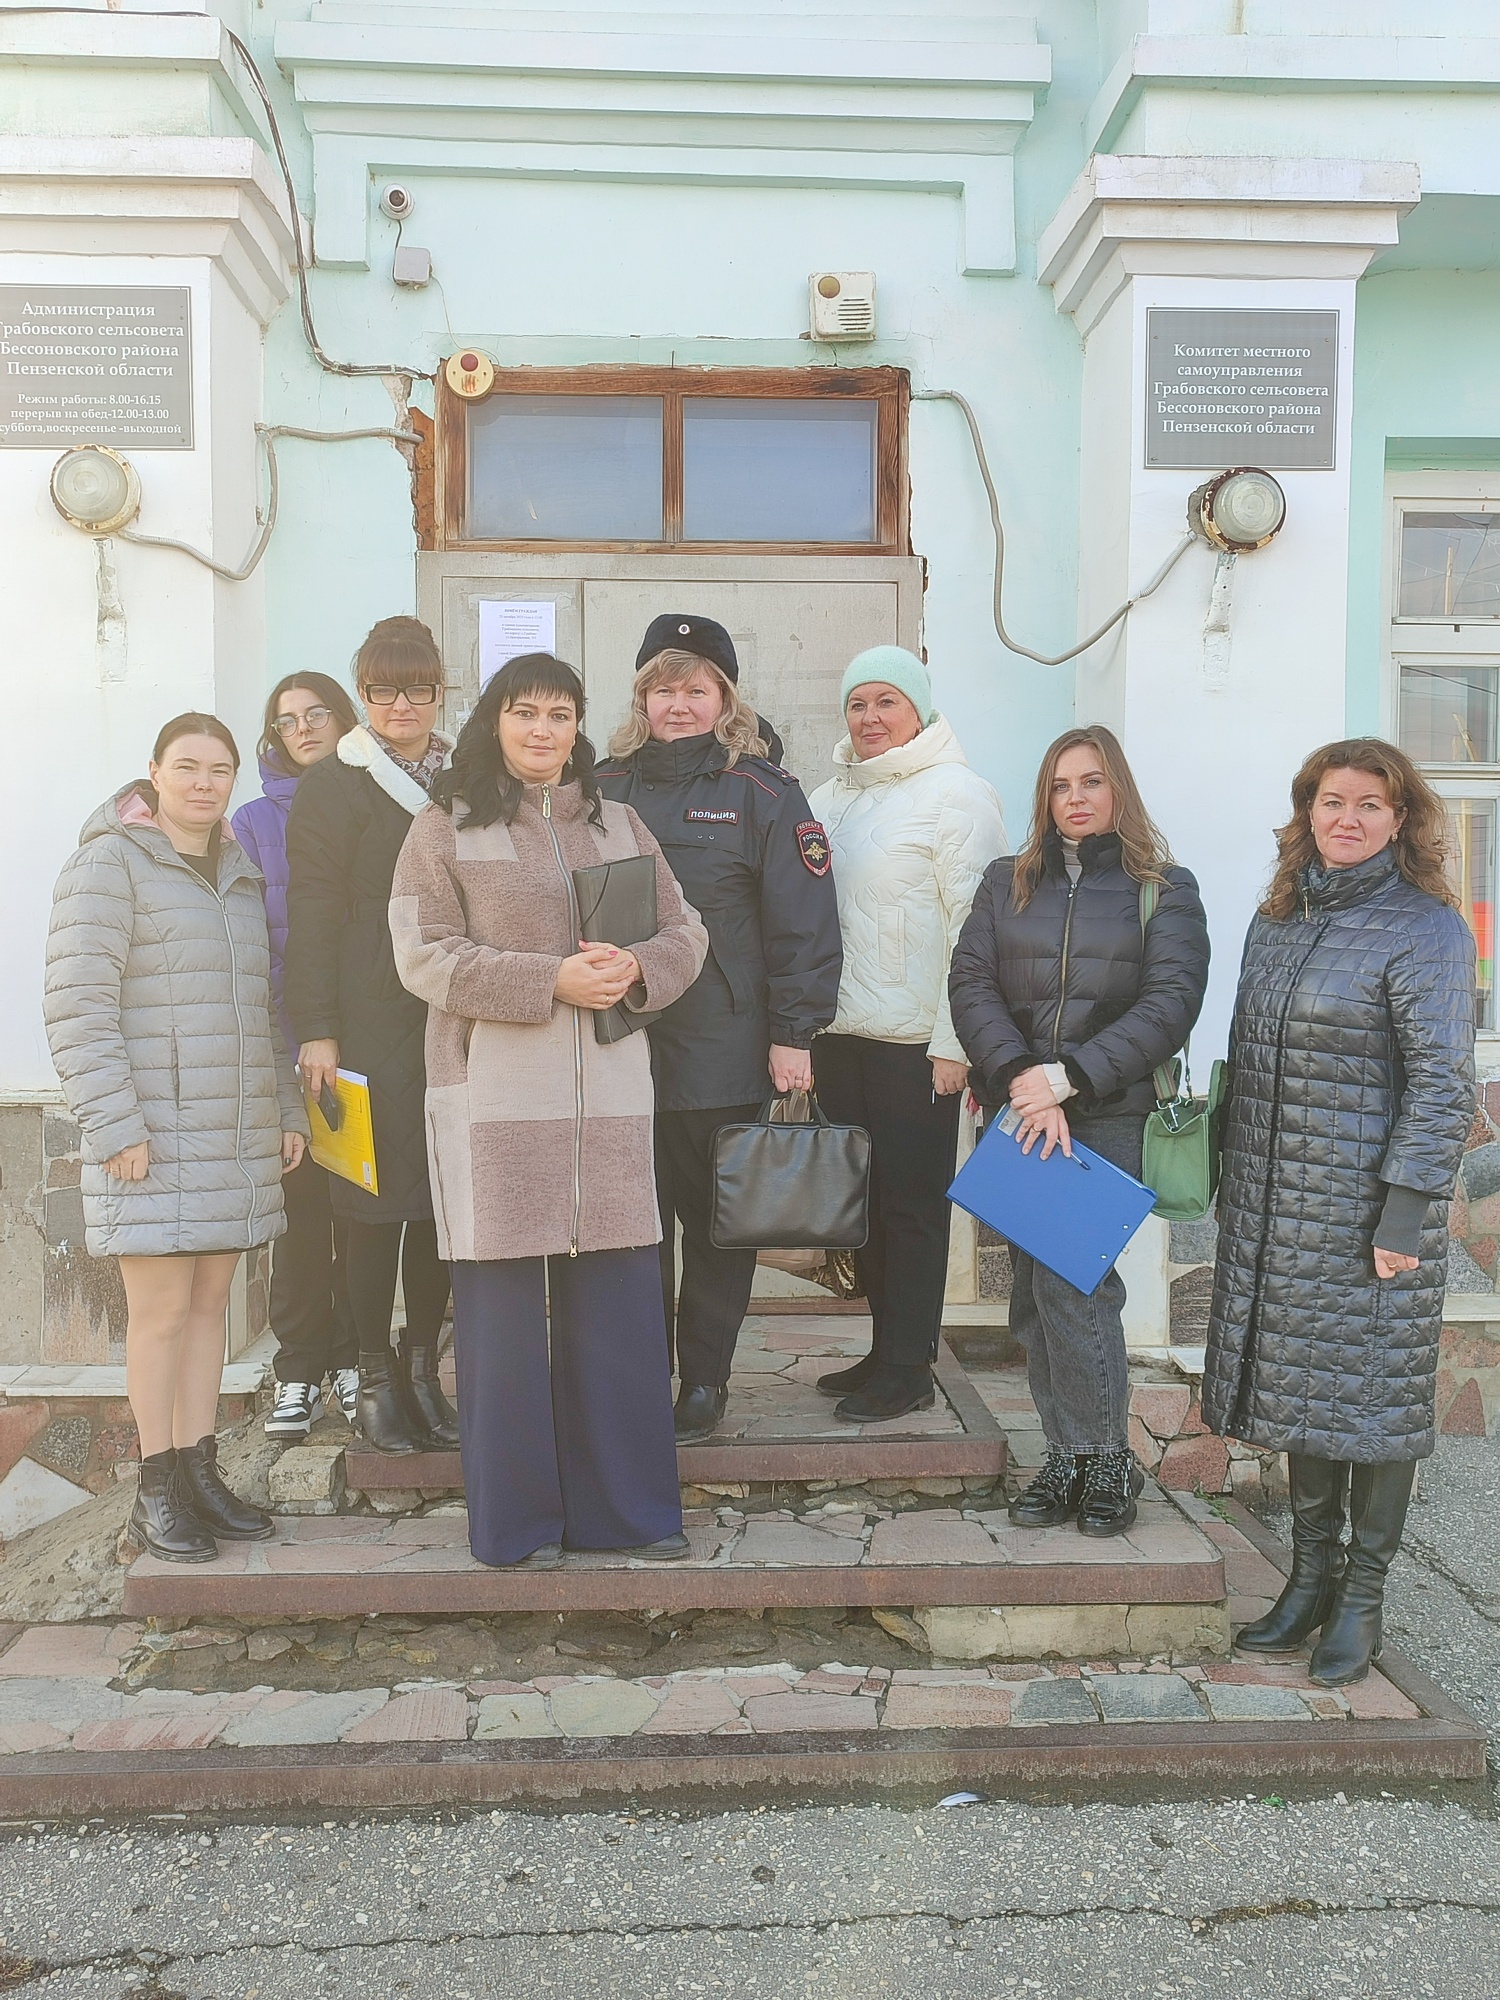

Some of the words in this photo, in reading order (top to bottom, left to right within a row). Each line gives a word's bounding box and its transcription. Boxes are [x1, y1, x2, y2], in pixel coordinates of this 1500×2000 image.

[22, 301, 156, 320] Администрация
[98, 326, 184, 337] сельсовета
[0, 341, 117, 356] Бессоновского
[121, 344, 179, 360] района
[1173, 343, 1240, 358] Комитет
[1243, 346, 1311, 359] местного
[7, 361, 105, 376] Пензенской
[109, 363, 174, 377] области
[1177, 364, 1303, 379] самоуправления
[1153, 381, 1246, 398] Грабовского
[1249, 384, 1329, 396] сельсовета
[18, 393, 57, 404] Режим
[61, 394, 107, 407] работы:
[109, 394, 161, 405] 8.00-16.15
[10, 410, 62, 421] перерыв
[65, 411, 78, 419] на
[81, 408, 169, 421] обед-12.00-13.00
[1157, 400, 1265, 415] Бессоновского
[1268, 402, 1321, 418] района
[119, 424, 182, 434] -выходной
[1162, 419, 1252, 434] Пензенской
[1256, 420, 1315, 434] области
[690, 811, 737, 820] ПОЛИЦИЯ
